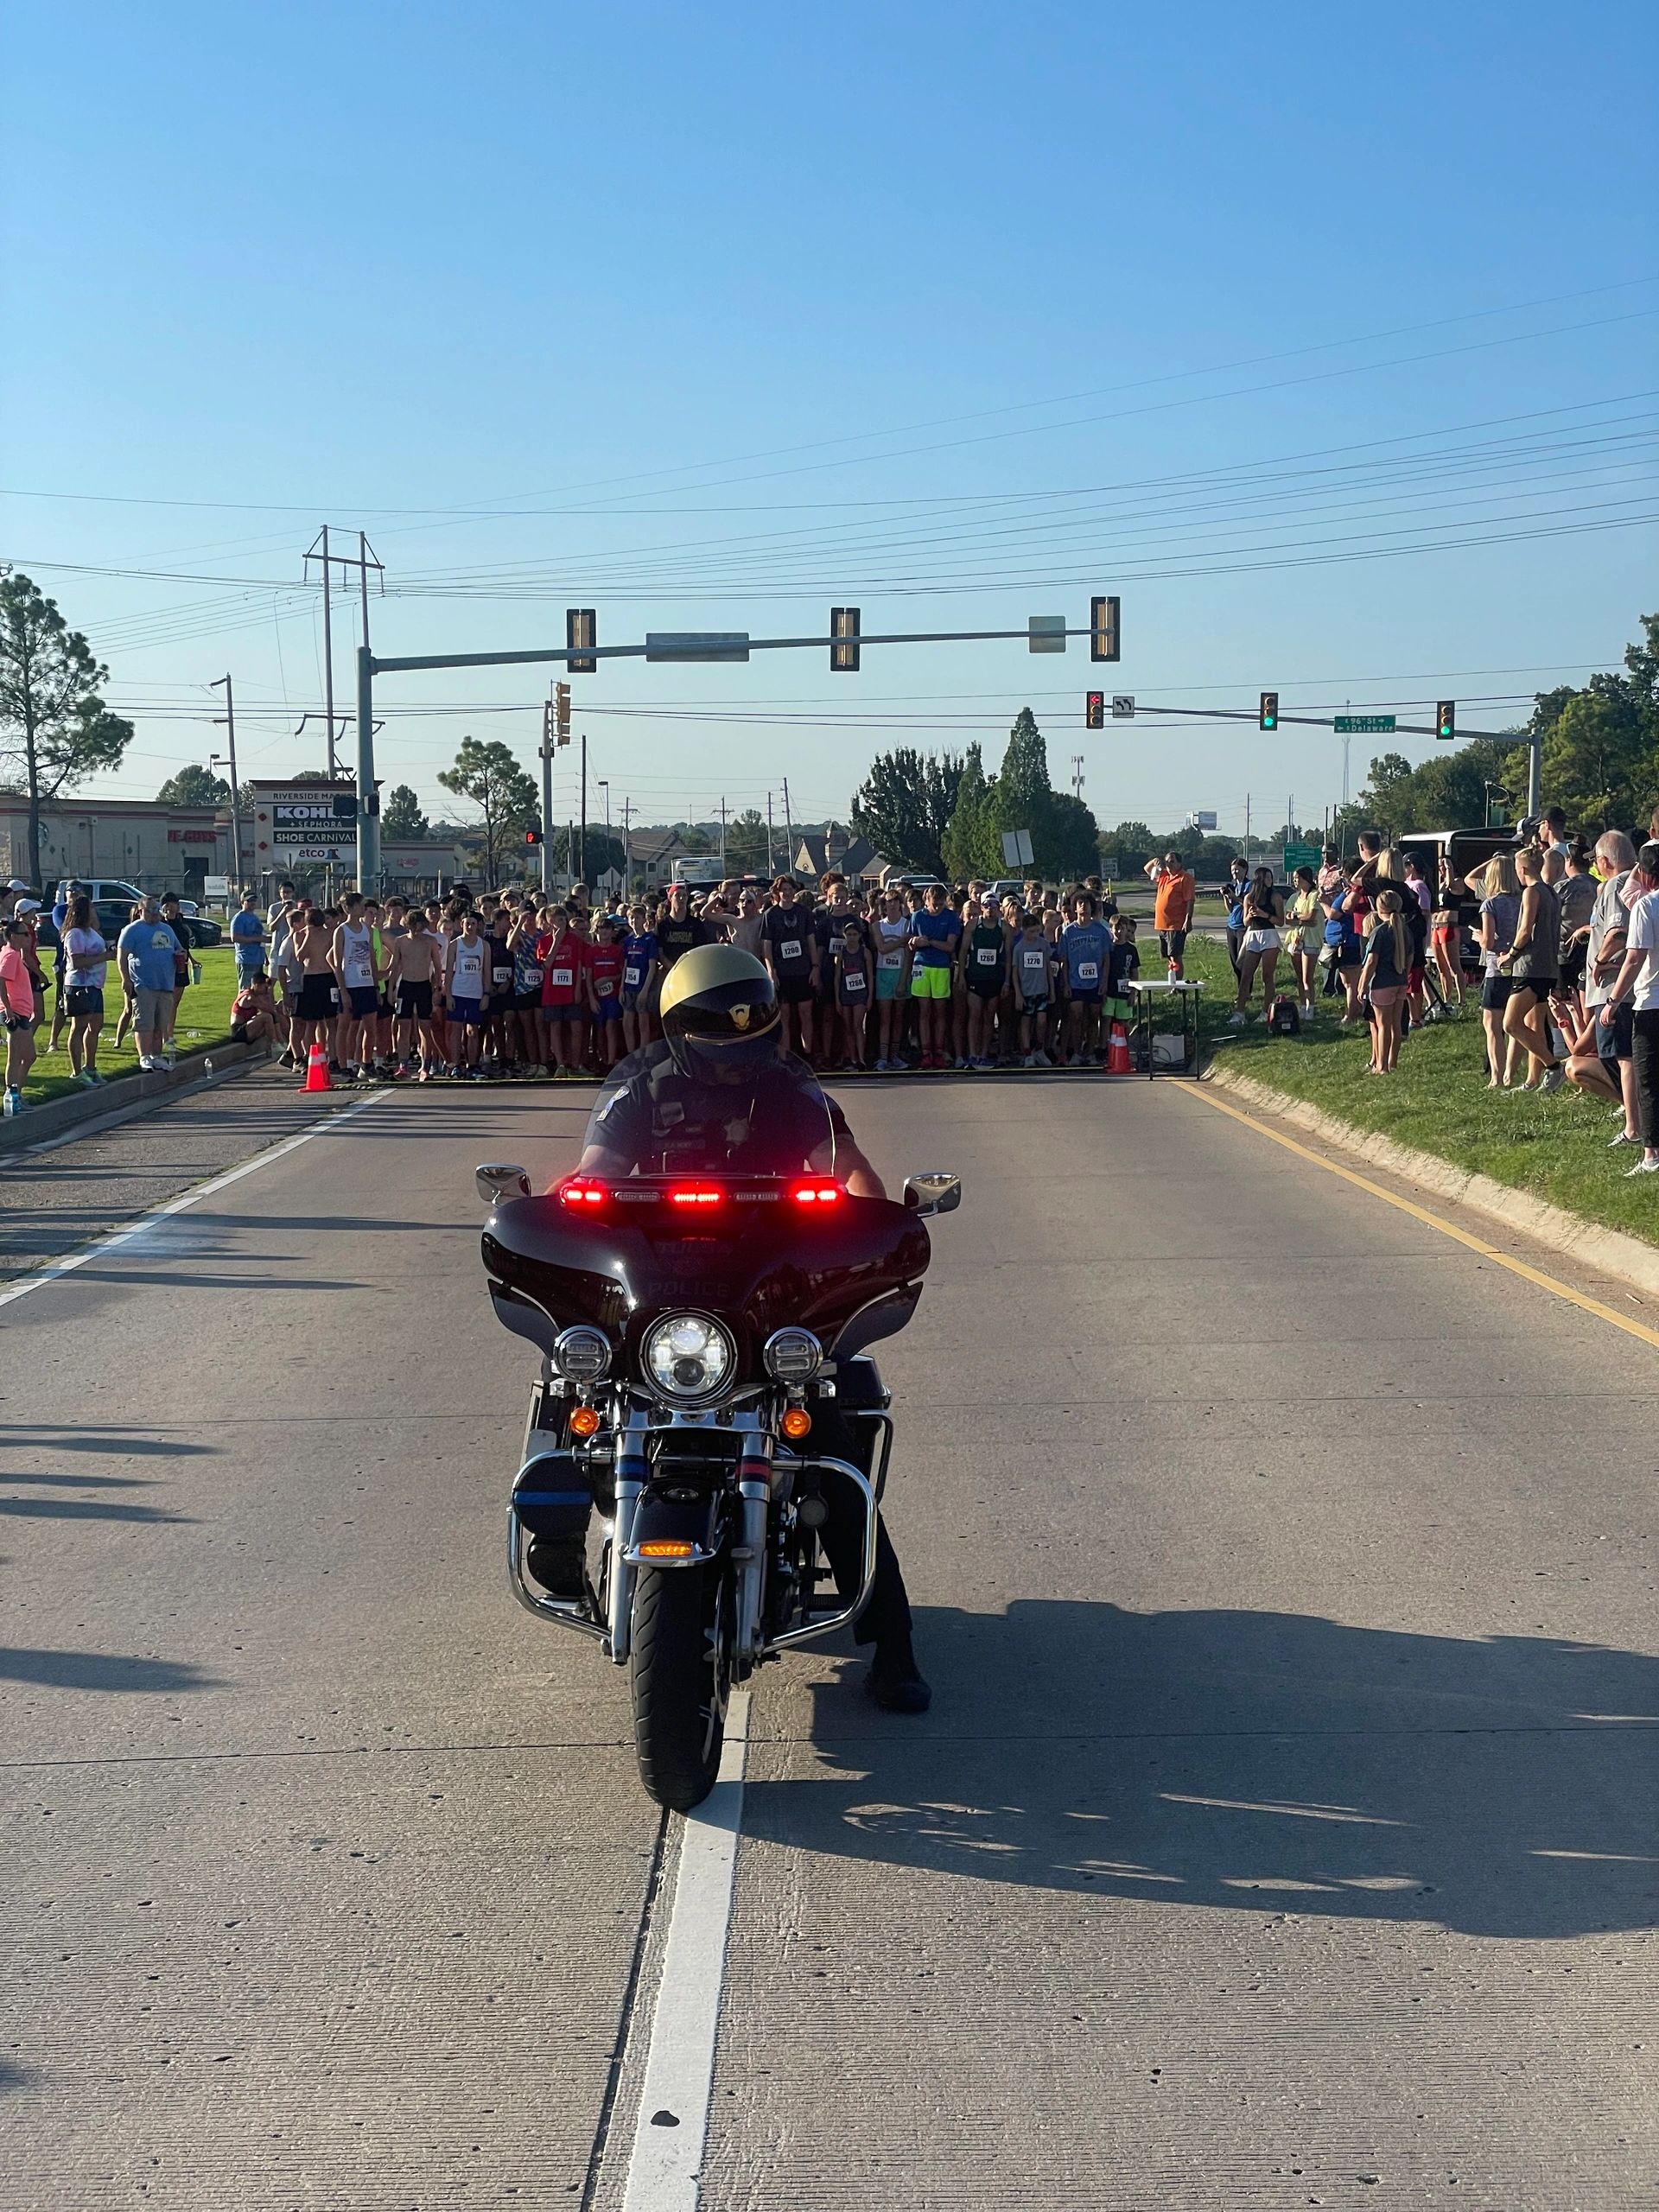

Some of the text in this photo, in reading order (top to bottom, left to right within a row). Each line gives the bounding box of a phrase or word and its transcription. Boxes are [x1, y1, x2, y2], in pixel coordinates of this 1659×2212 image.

[277, 807, 355, 818] KOHL
[276, 833, 304, 842] SHOE
[299, 849, 325, 857] etco
[648, 1281, 730, 1297] POLICE
